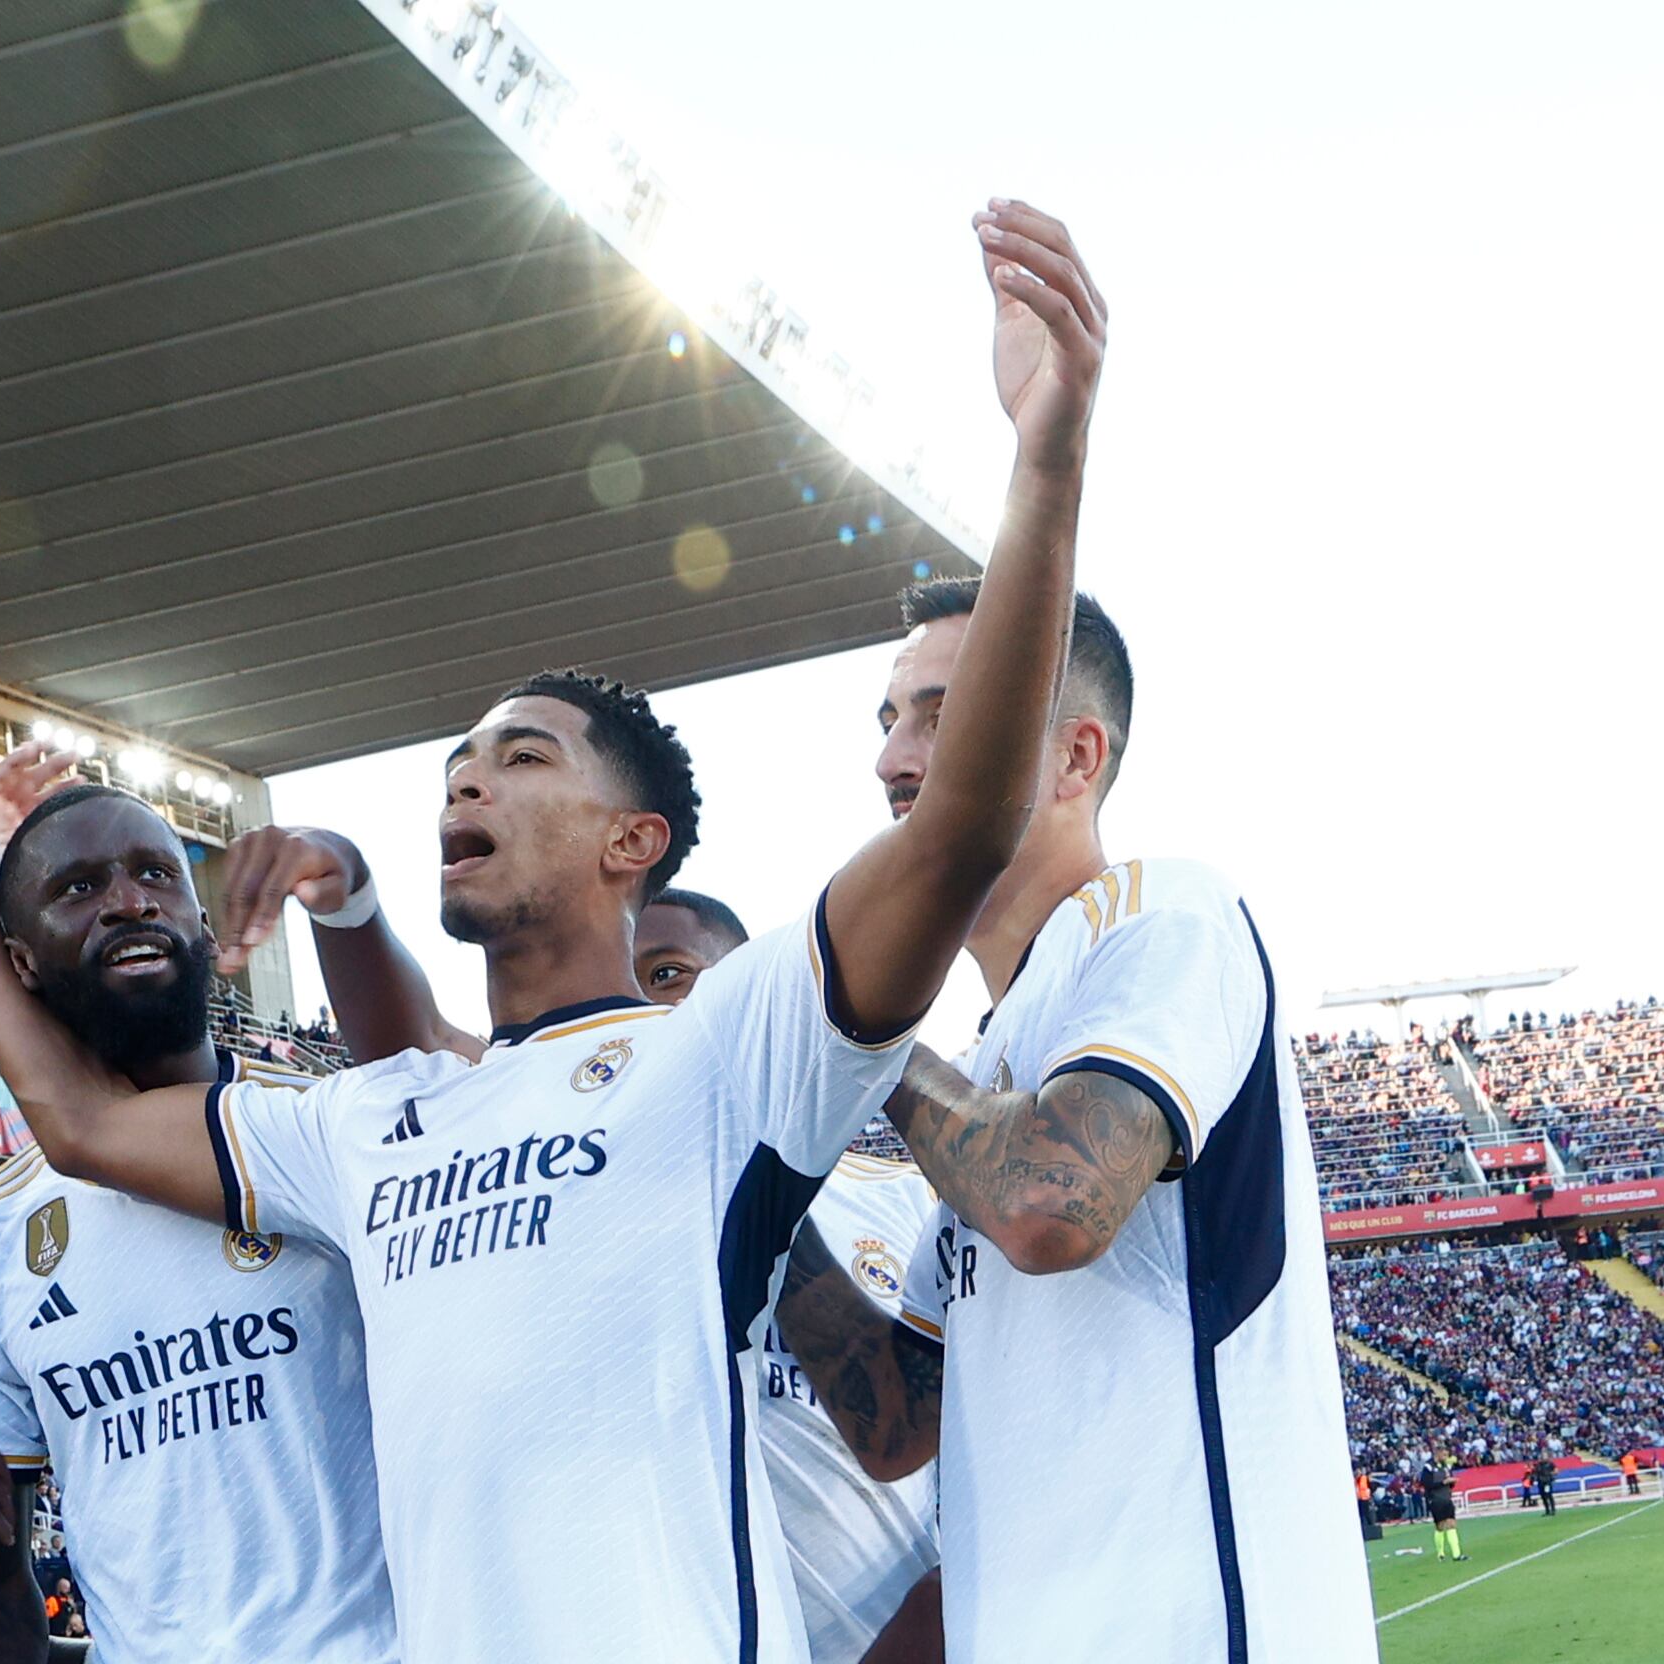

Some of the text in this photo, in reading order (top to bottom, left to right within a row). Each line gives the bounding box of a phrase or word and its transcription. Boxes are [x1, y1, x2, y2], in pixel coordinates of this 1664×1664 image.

[366, 1128, 607, 1237] Emirates
[1448, 1206, 1498, 1219] BARCELONA
[383, 1194, 552, 1287] FLY BETTER
[39, 1307, 298, 1420] Emirates
[101, 1373, 267, 1465] FLY BETTER
